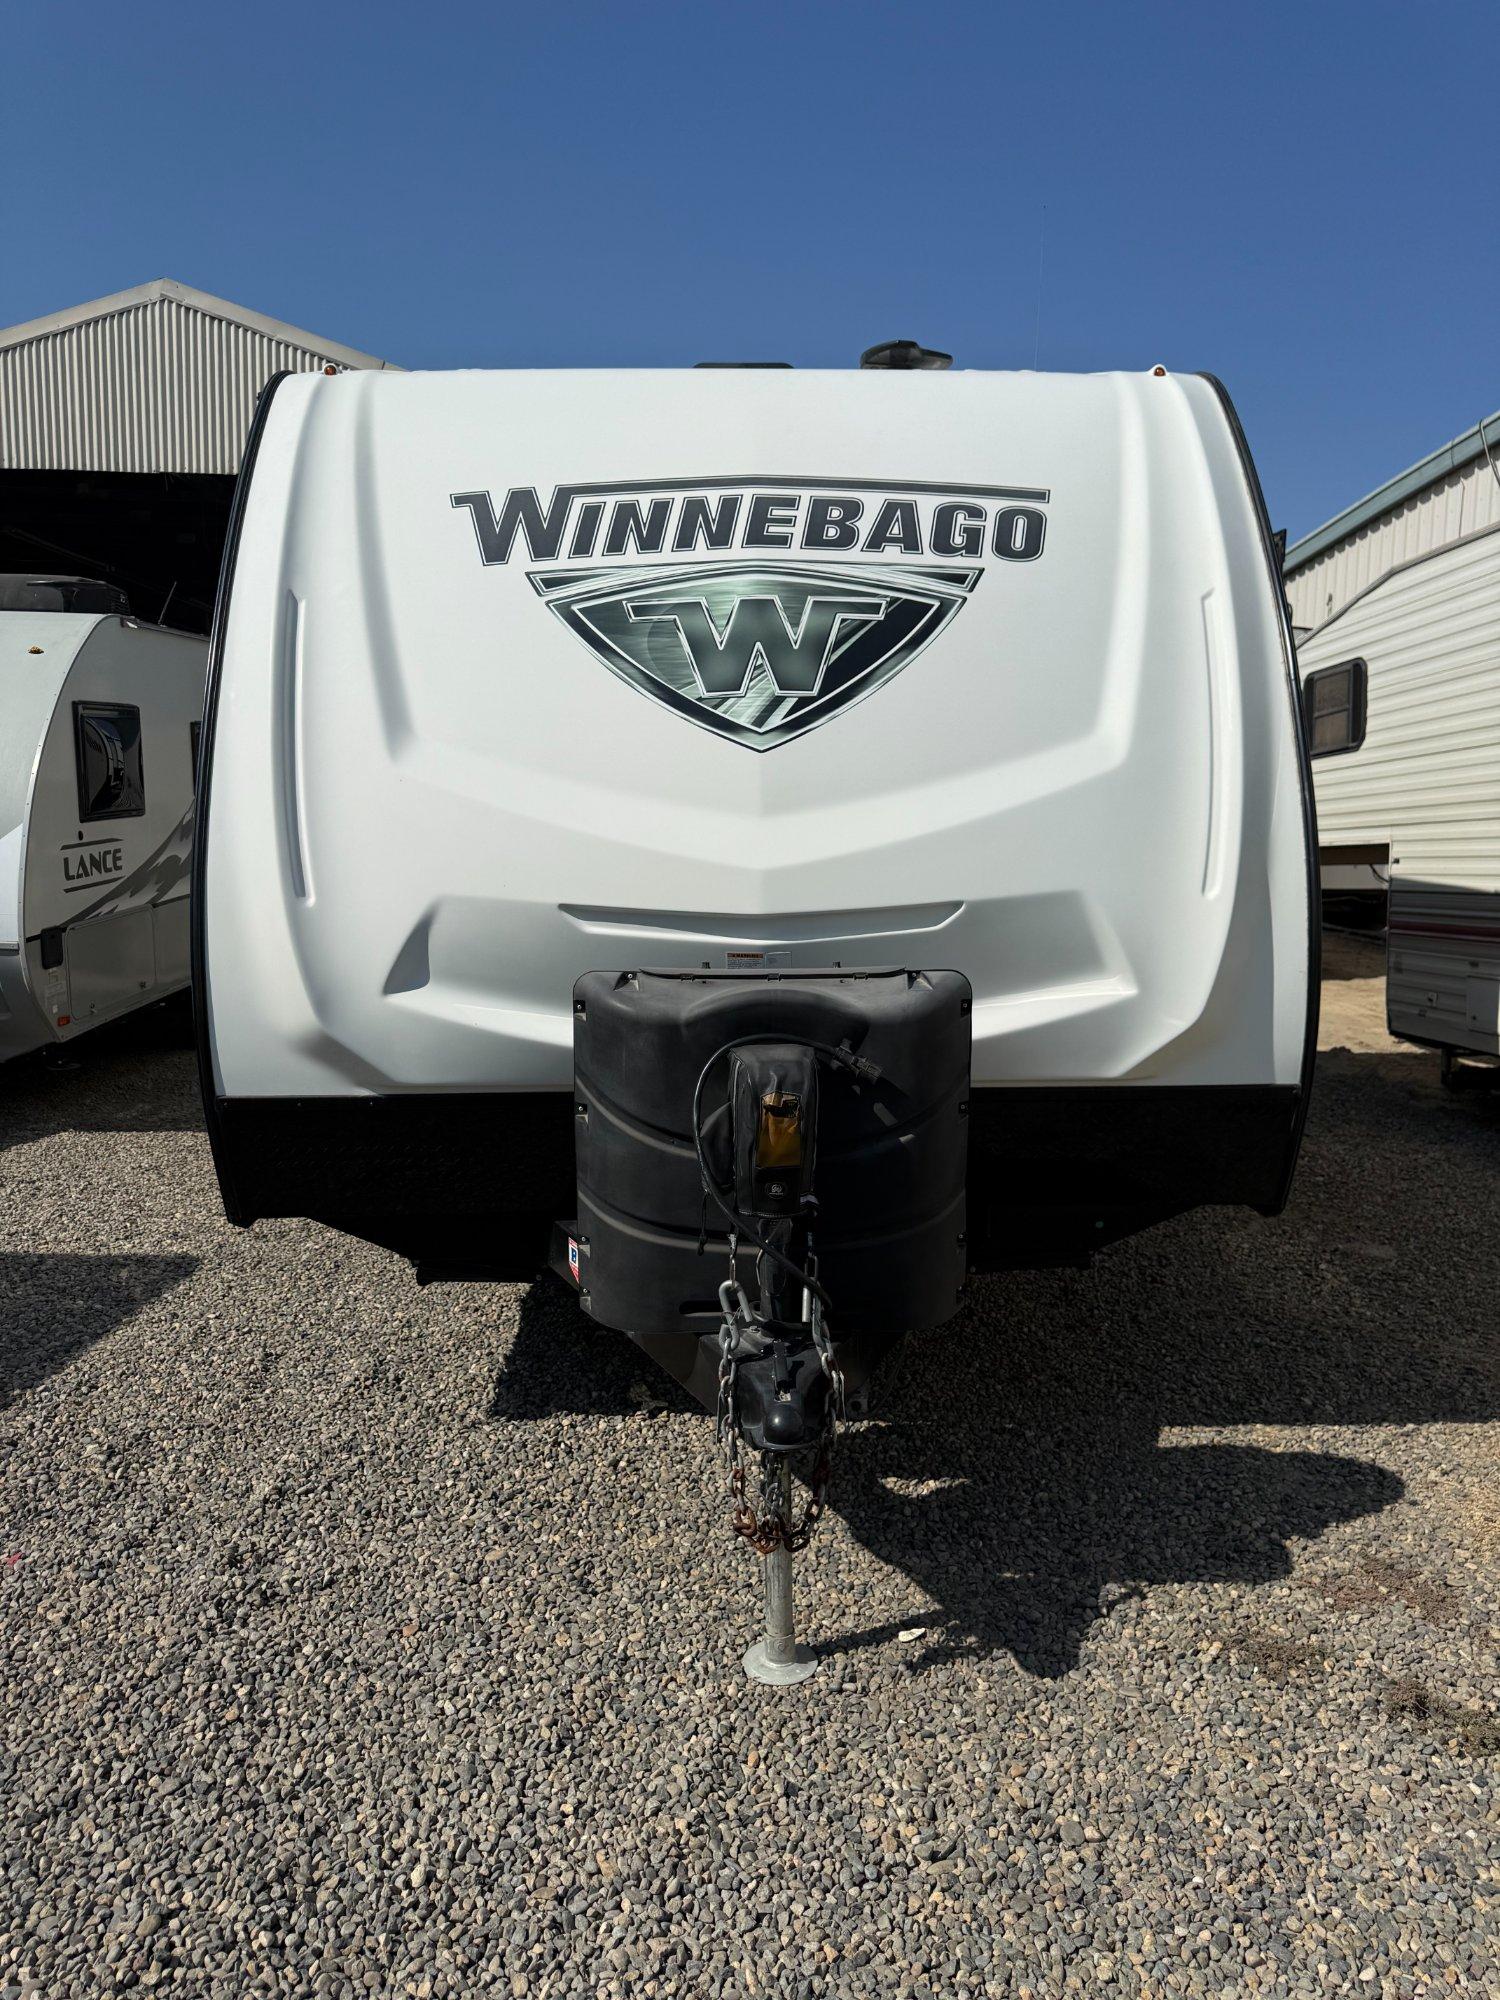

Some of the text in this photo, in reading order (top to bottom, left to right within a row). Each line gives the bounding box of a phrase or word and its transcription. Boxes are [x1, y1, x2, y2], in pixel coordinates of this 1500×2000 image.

[450, 475, 1050, 566] WINNEBAGO
[625, 596, 888, 697] W
[63, 848, 123, 881] LANCE
